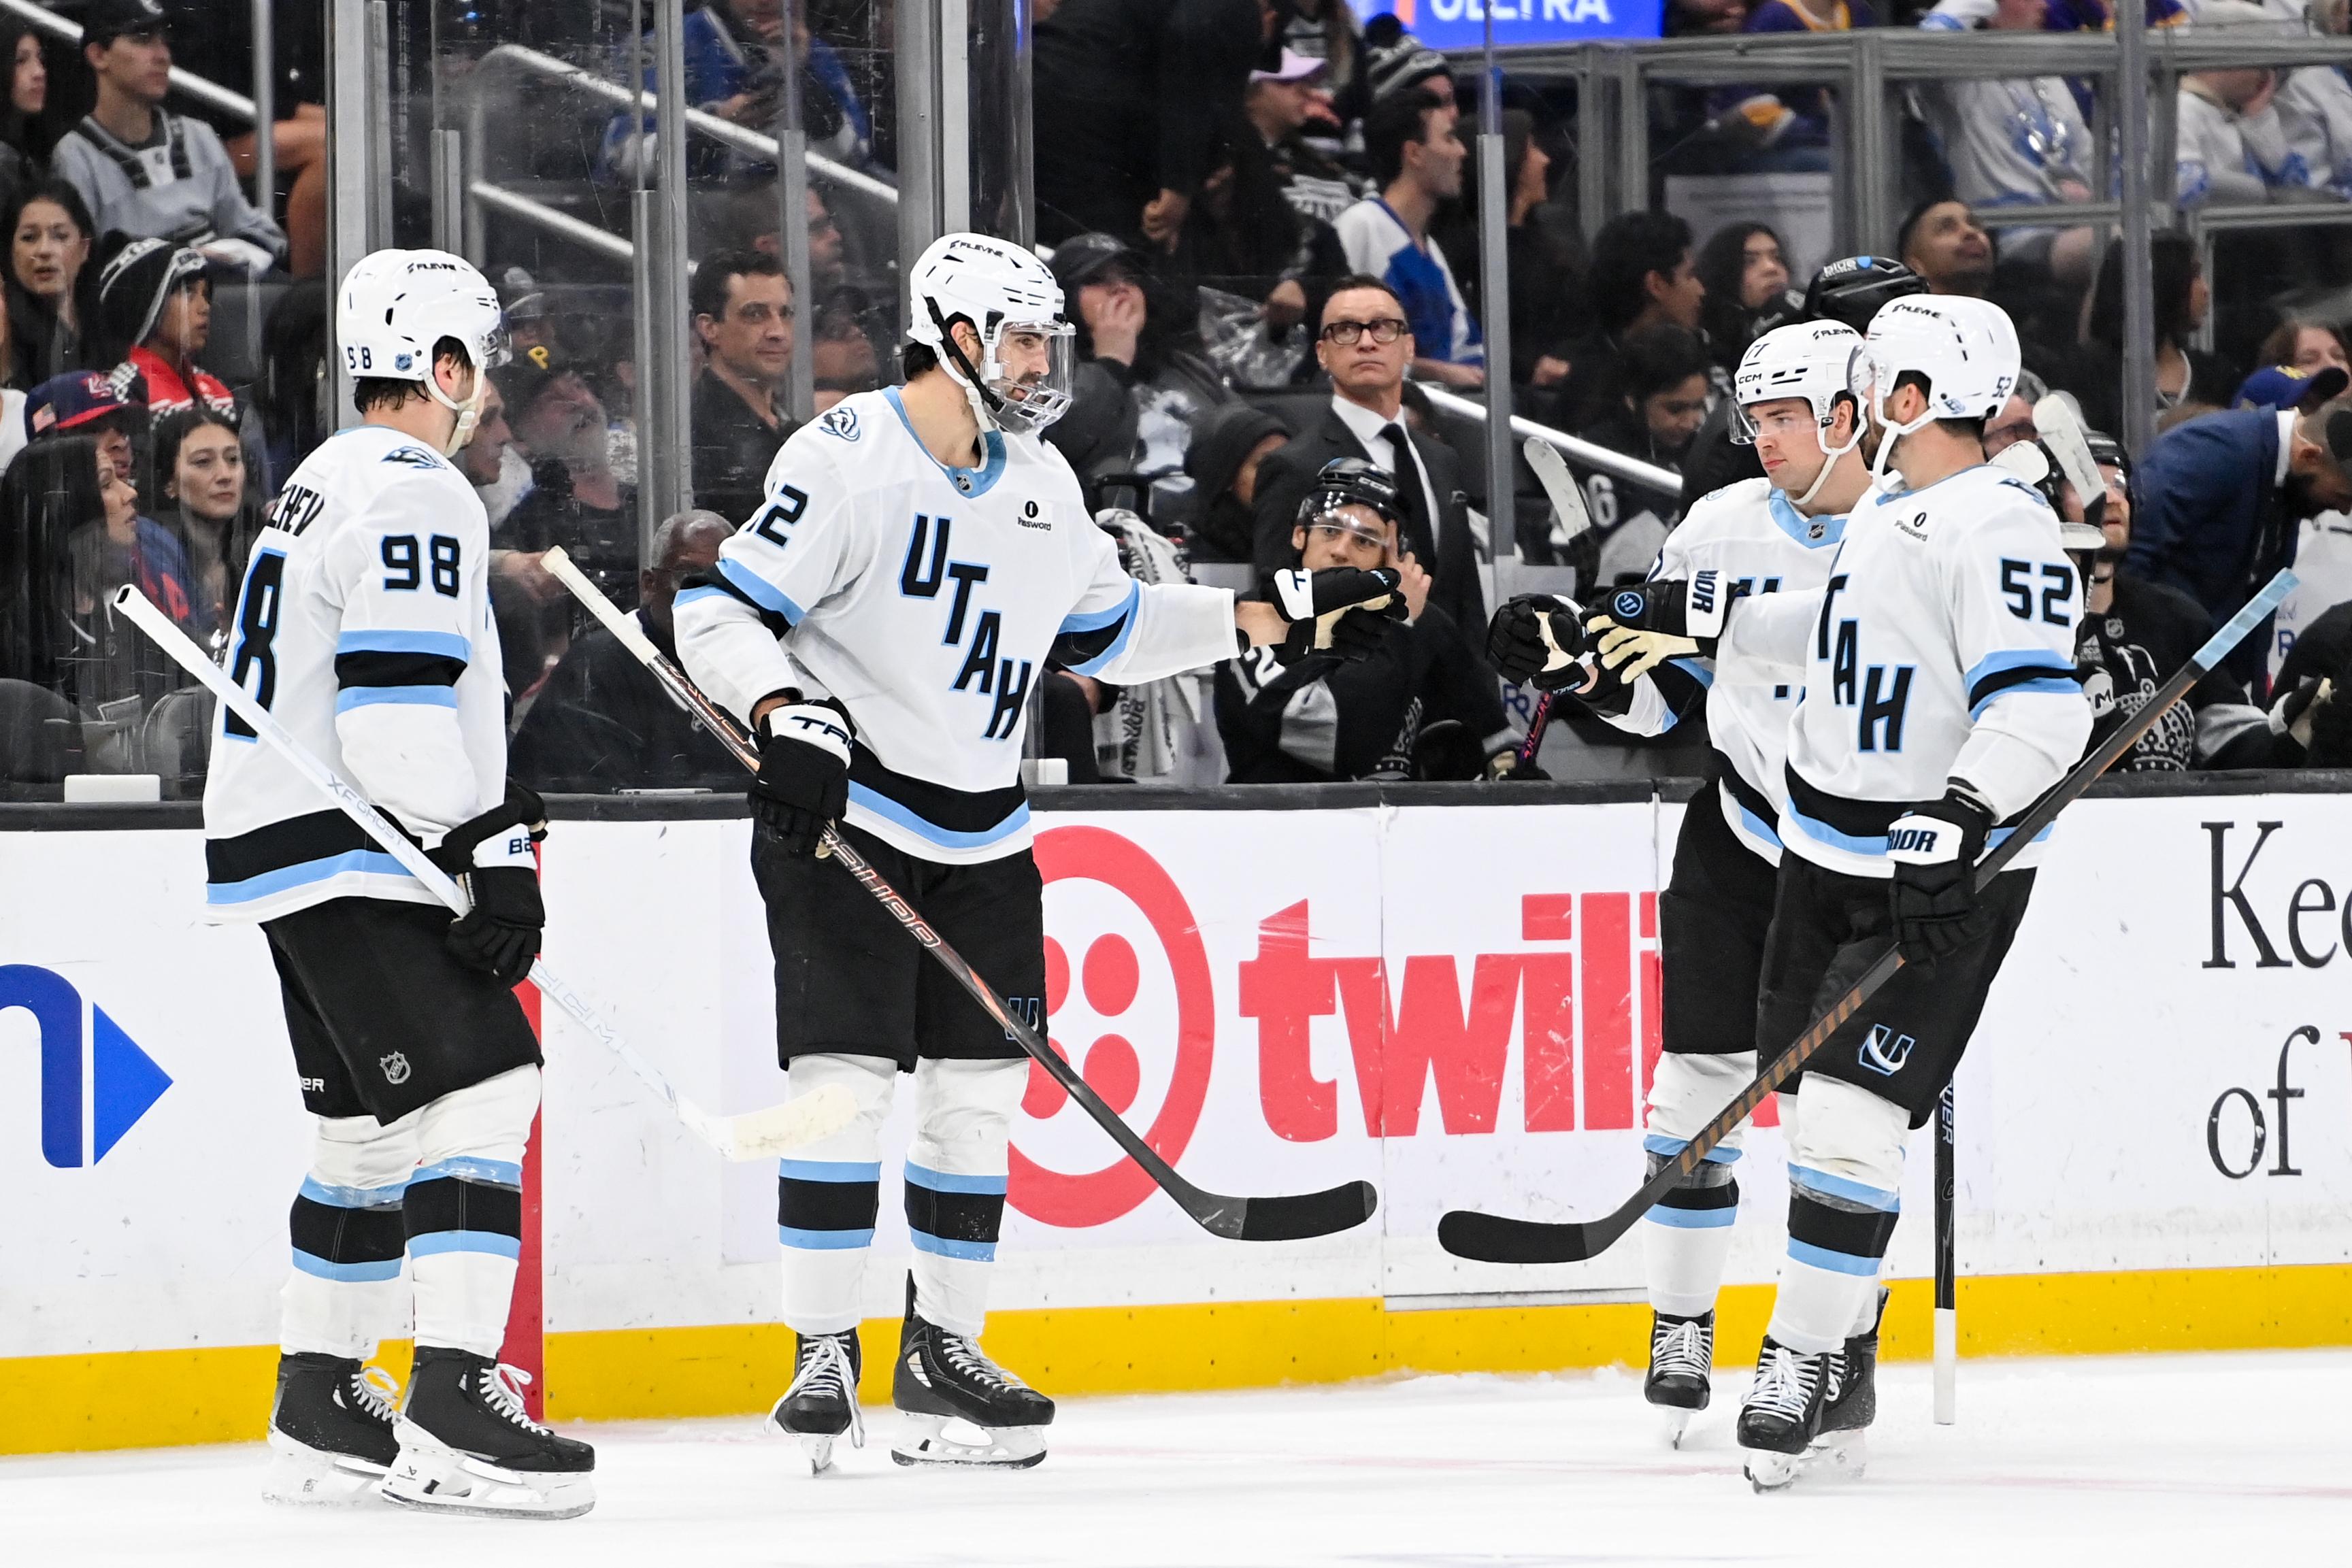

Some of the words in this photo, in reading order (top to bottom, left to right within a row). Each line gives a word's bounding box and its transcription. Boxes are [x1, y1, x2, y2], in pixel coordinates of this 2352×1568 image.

[1738, 372, 1762, 384] CCM
[744, 479, 810, 551] 2
[380, 532, 462, 600] 98
[1999, 556, 2073, 628] 52
[899, 512, 1033, 741] UTAH
[1817, 539, 1918, 754] TAH
[357, 800, 406, 846] GHOST
[2200, 820, 2352, 969] Ke
[2206, 1024, 2321, 1180] of
